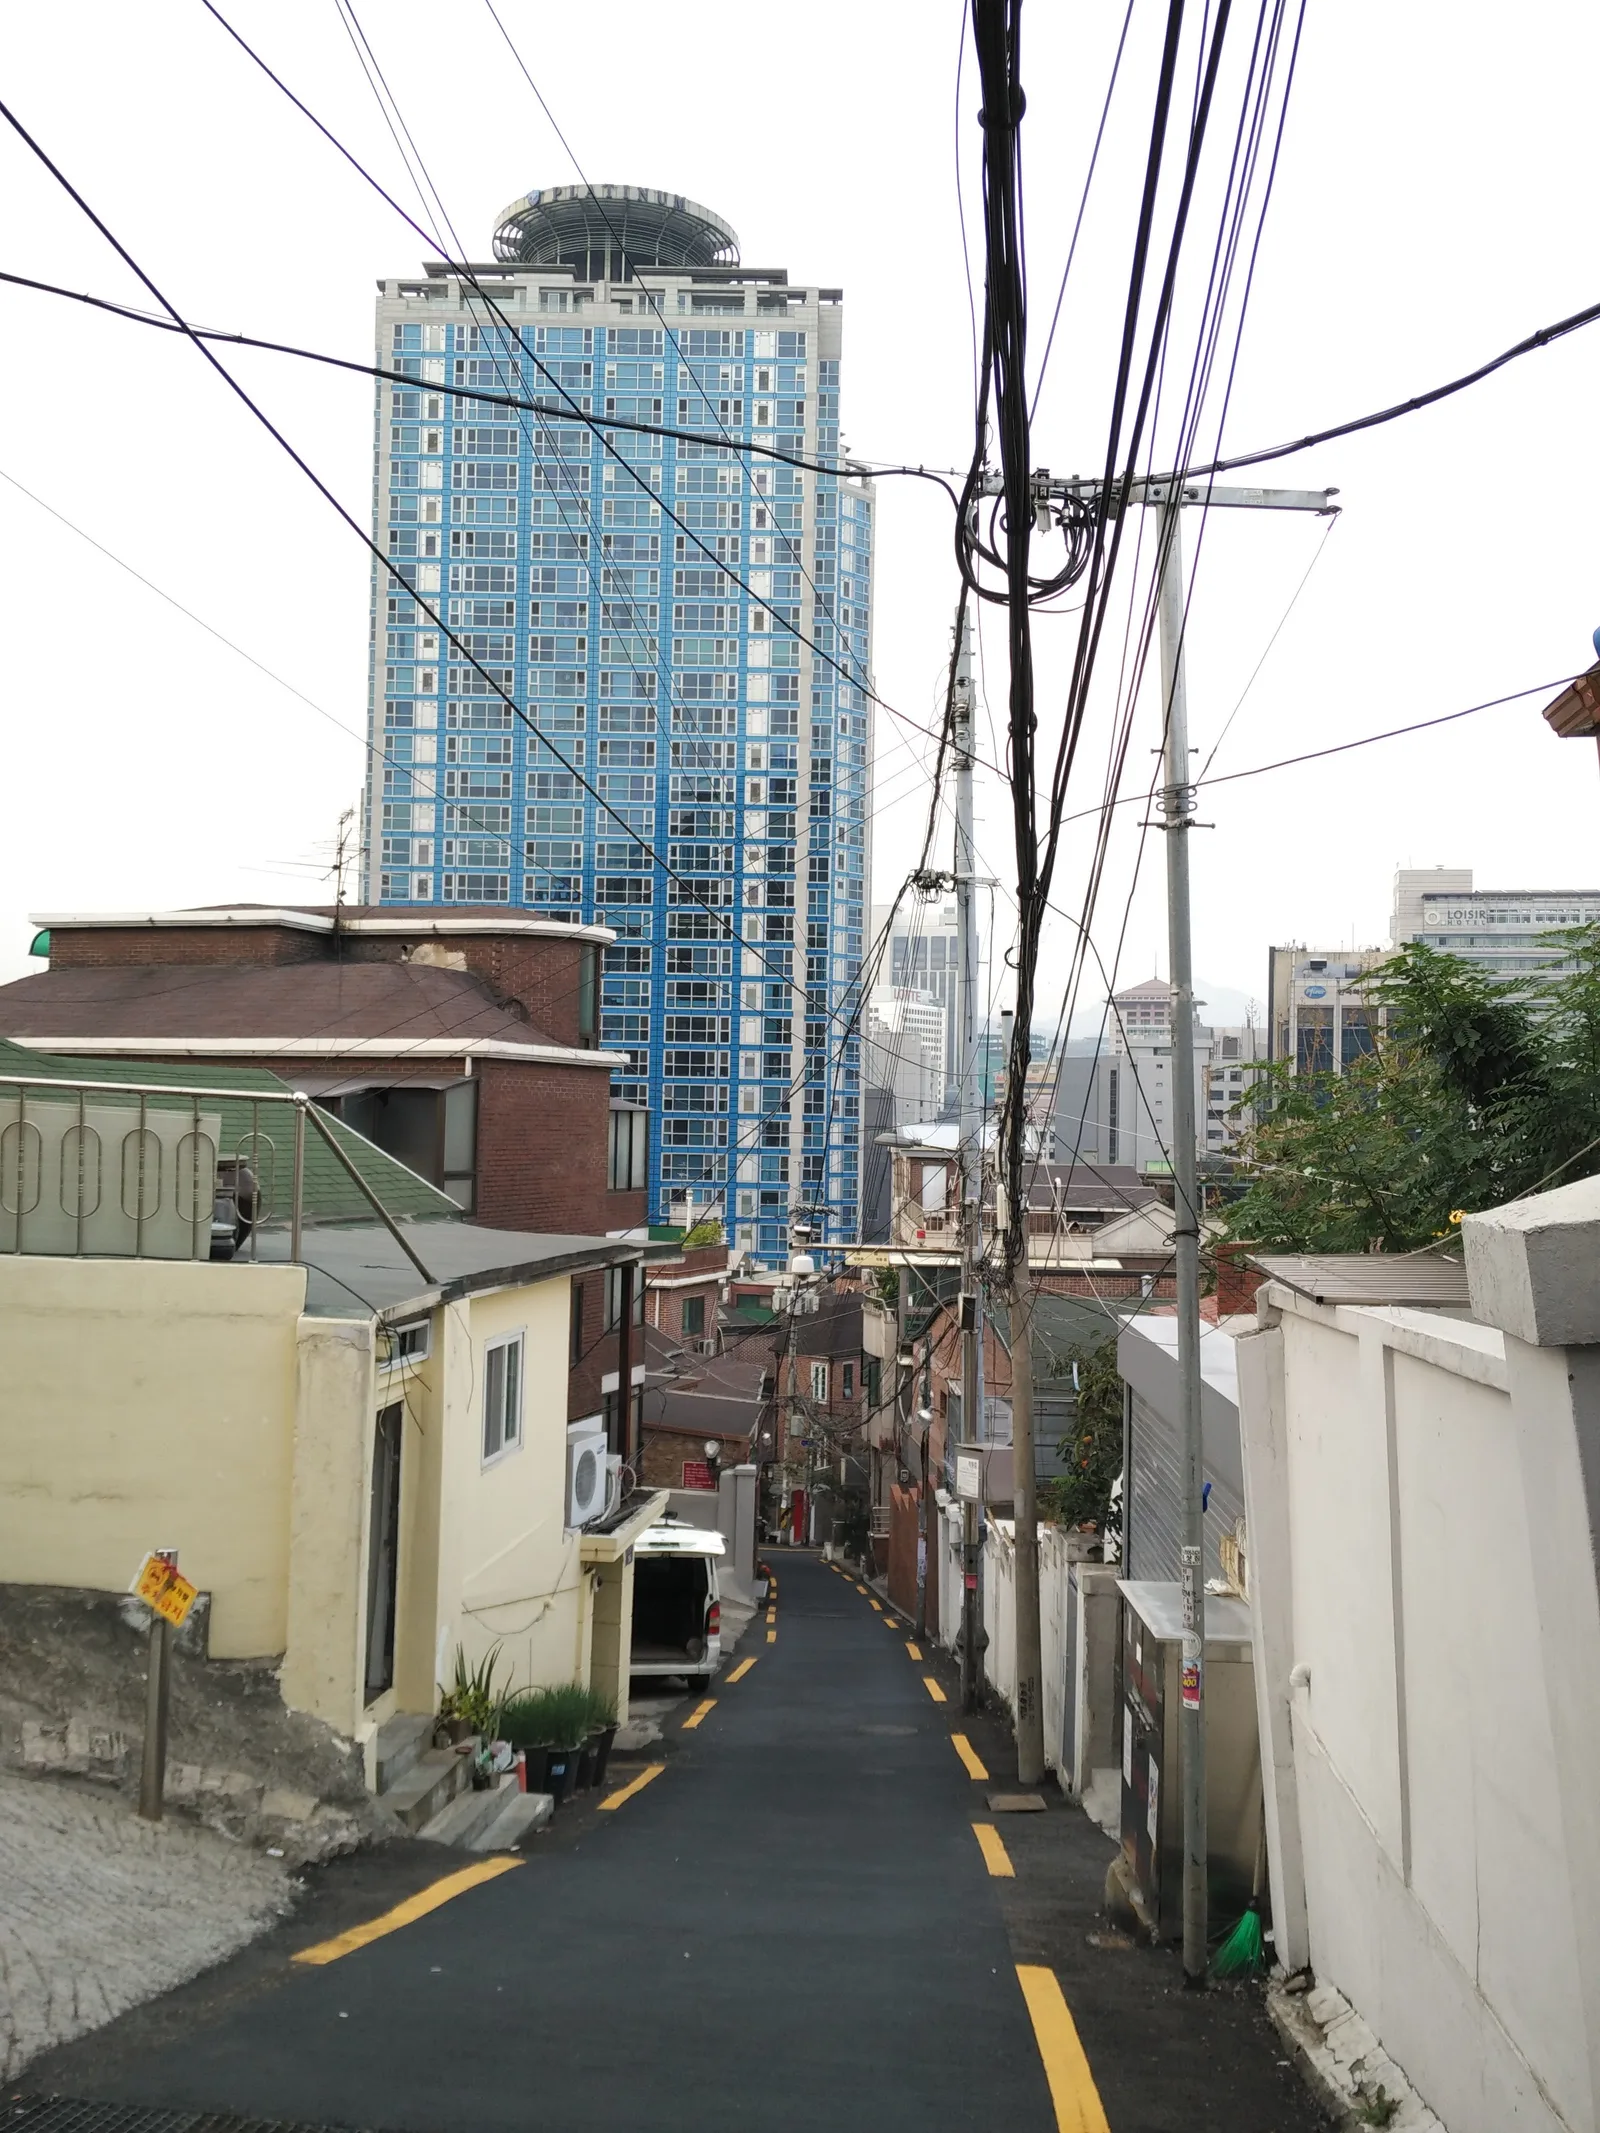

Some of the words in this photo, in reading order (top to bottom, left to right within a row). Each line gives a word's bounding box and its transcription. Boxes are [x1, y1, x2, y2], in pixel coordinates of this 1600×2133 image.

[552, 184, 686, 211] PLATINUM
[1447, 910, 1486, 920] LOISIR
[894, 988, 921, 1002] LOTTE
